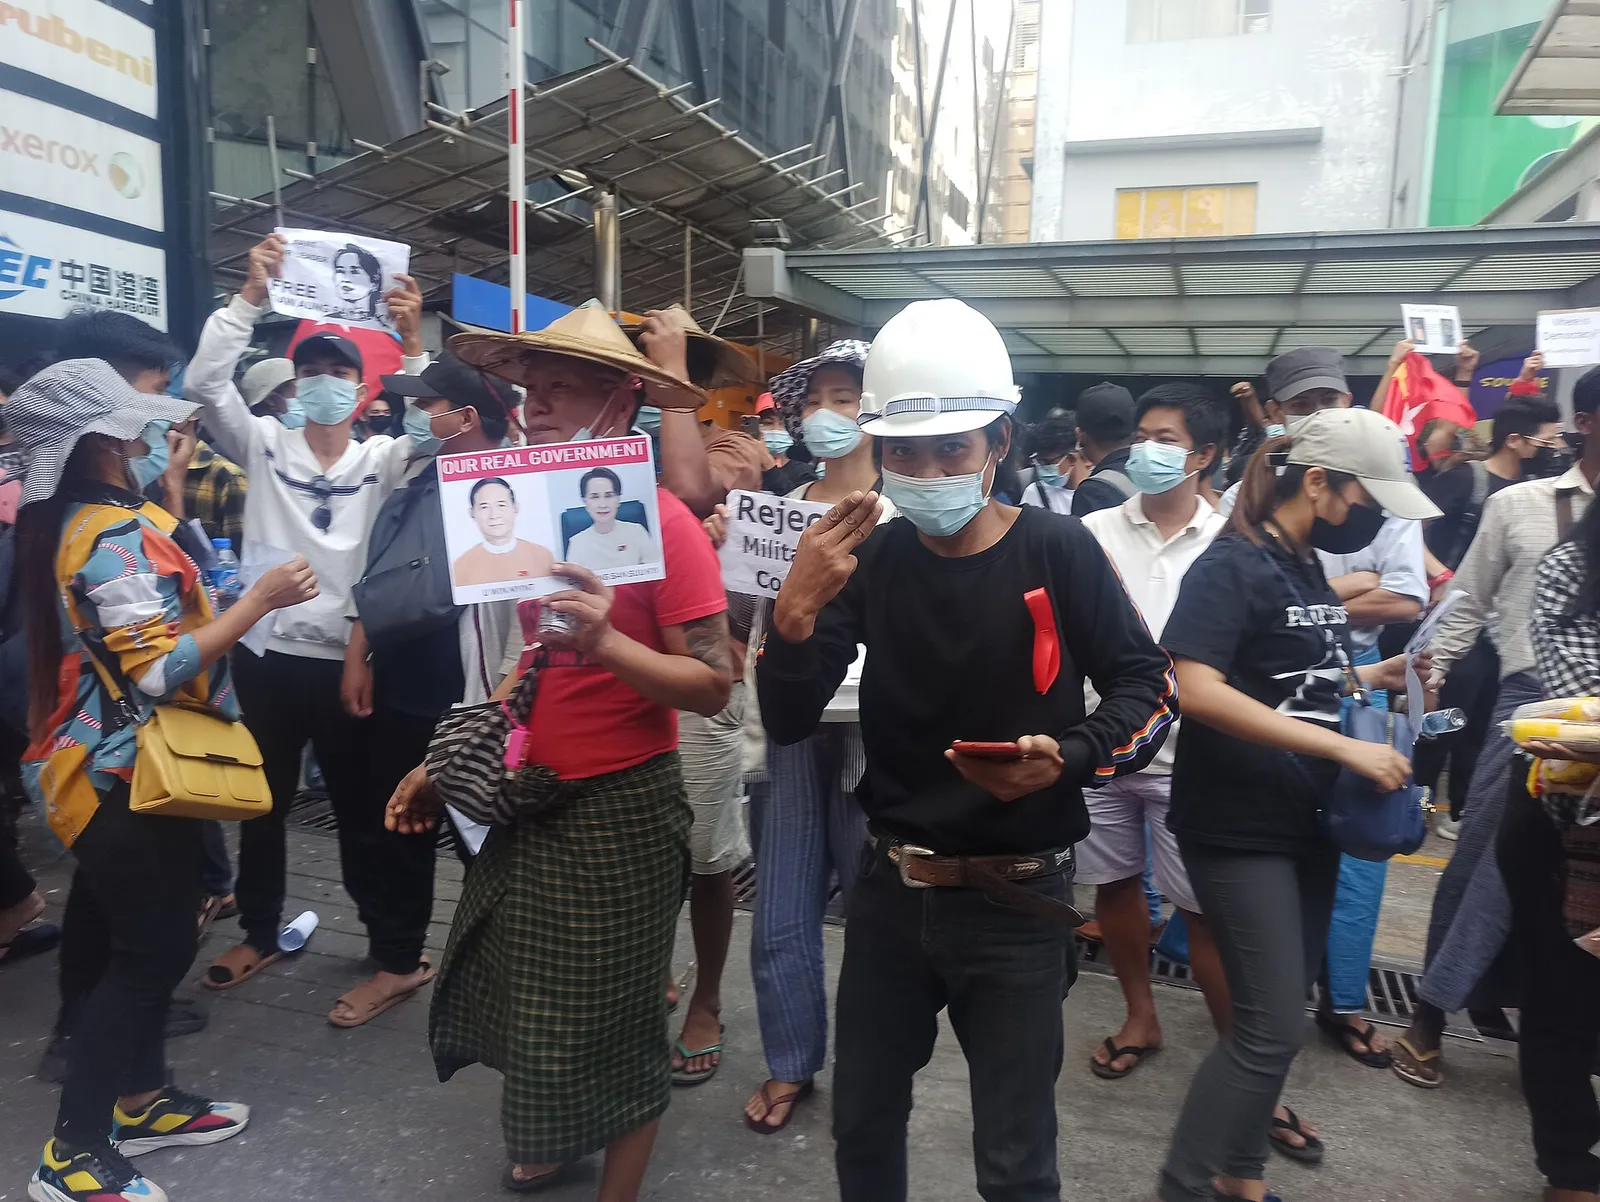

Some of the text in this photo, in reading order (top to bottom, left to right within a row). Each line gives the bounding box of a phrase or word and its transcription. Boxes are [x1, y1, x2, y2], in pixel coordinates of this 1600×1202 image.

[0, 125, 100, 178] xerox
[272, 278, 317, 300] FREE
[442, 441, 646, 475] OUR REAL GOVERNMENT
[738, 495, 823, 535] Rejec
[757, 570, 780, 592] Co
